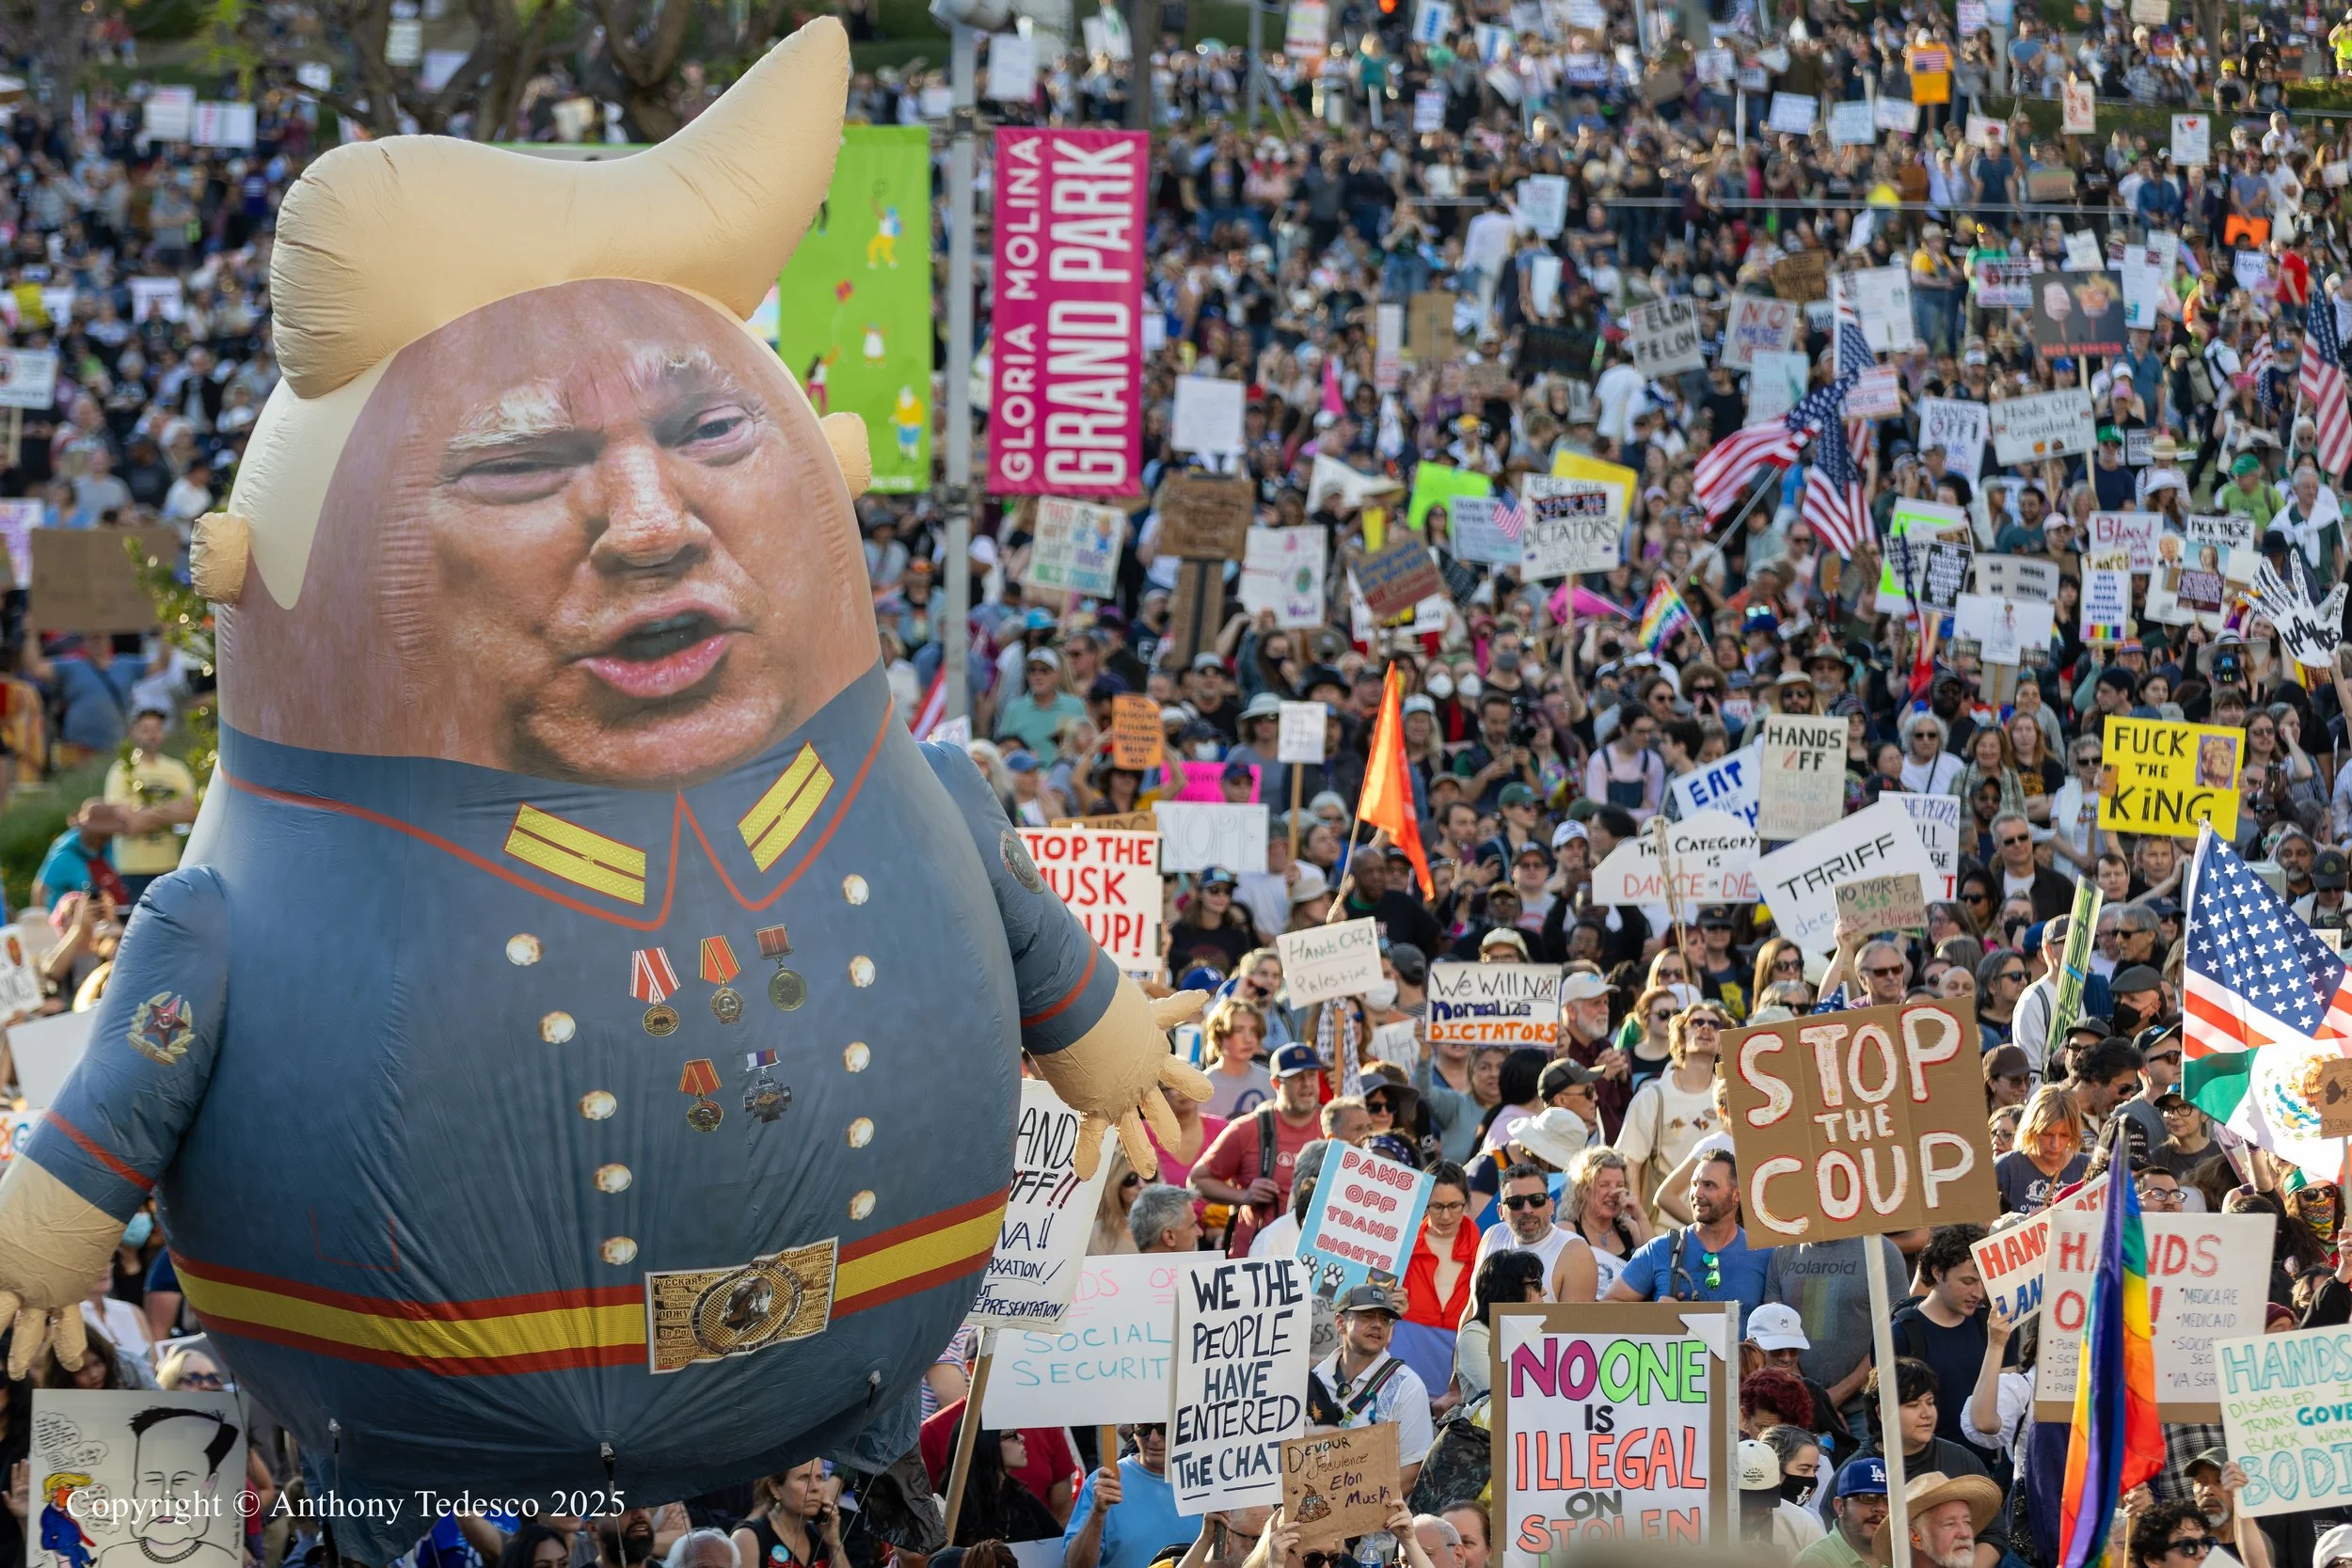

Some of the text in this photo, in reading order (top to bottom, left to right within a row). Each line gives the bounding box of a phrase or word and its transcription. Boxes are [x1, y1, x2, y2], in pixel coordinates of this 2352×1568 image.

[1000, 136, 1042, 482] GLORIA MOLINA
[1043, 137, 1136, 487] GRAND PARK
[1631, 300, 1692, 330] FELON
[1740, 300, 1788, 330] NO
[1636, 331, 1697, 362] FELON
[2041, 341, 2123, 356] NO KINGS
[1523, 515, 1617, 548] DICTATORS
[2282, 616, 2343, 657] HANDS
[1768, 724, 1842, 750] HANDS
[2114, 724, 2189, 759] FUCK
[1688, 760, 1743, 809] EAT
[2135, 763, 2169, 779] THE
[1921, 798, 1959, 831] PEOPLE
[1020, 833, 1155, 866] TOP THE
[1154, 805, 1266, 875] NOPE
[1638, 835, 1757, 857] TH CATEGORY
[1707, 855, 1722, 869] IS
[1776, 831, 1897, 903] TARIFF
[1721, 871, 1759, 900] DIE
[1836, 886, 1857, 905] NO
[1432, 970, 1471, 998] We
[1477, 971, 1518, 997] Will
[1429, 1022, 1559, 1044] DICTATORS
[1738, 1004, 1964, 1129] STOP
[1813, 1102, 1896, 1146] THE
[1343, 1150, 1415, 1191] PAWS
[1750, 1130, 1975, 1235] COUP
[1344, 1184, 1397, 1213] OFF
[1327, 1205, 1398, 1242] TRANS
[1316, 1233, 1392, 1271] RIGHTS
[1190, 1259, 1304, 1314] WE THE
[2183, 1288, 2239, 1307] MEDICARE
[1192, 1307, 1295, 1364] PEOPLE
[2180, 1312, 2237, 1329] MEDICAID
[1023, 1321, 1173, 1354] SOCIAL
[1203, 1360, 1274, 1404] HAVE
[2171, 1371, 2191, 1389] VA
[1173, 1394, 1302, 1448] ENTERED
[1583, 1403, 1615, 1434] IS
[2227, 1390, 2315, 1419] DISABLED
[2239, 1410, 2296, 1436] TRANS
[1515, 1425, 1708, 1492] ILLEGAL
[2244, 1431, 2305, 1456] BLACK
[1170, 1437, 1282, 1490] THE CHAT
[1870, 1465, 1886, 1482] LA
[1329, 1470, 1363, 1492] Elon
[1565, 1489, 1624, 1521] ON
[1516, 1506, 1703, 1555] STOLEN
